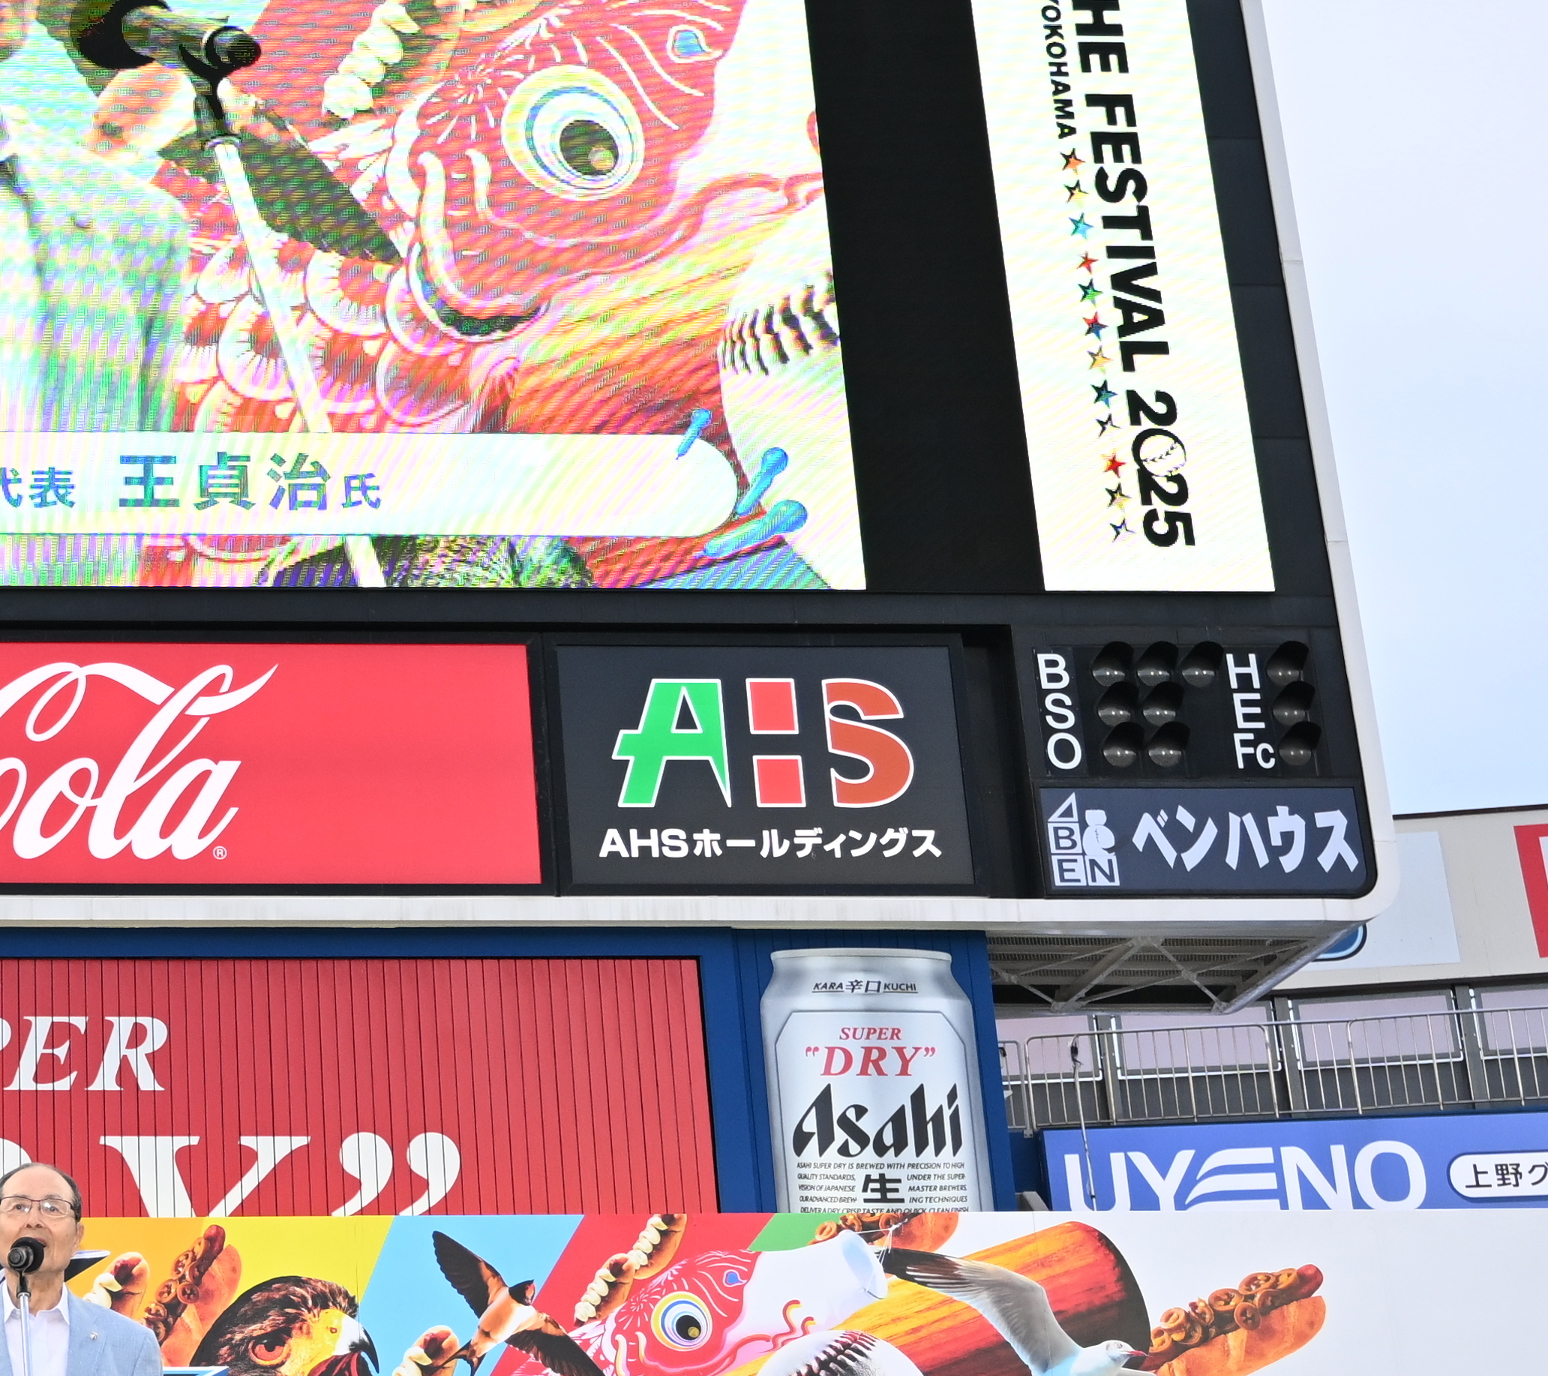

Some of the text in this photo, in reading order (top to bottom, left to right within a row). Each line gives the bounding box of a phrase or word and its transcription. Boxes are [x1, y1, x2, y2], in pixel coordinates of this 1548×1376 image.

[1084, 92, 1169, 372] FESTIVAL
[1127, 390, 1195, 548] 2025
[1037, 652, 1260, 690] B H
[1045, 692, 1265, 731] S E
[612, 677, 914, 809] AHS
[1048, 735, 1083, 772] O
[599, 827, 942, 861] AHSホールディングス
[1132, 805, 1360, 874] ベンハウス
[813, 980, 917, 993] KARA 辛口 KUCHI
[839, 1027, 902, 1040] SUPER
[793, 1083, 962, 1158] Asahi
[833, 1162, 847, 1170] DRY
[856, 1162, 885, 1170] BREWED
[887, 1162, 905, 1170] WITH
[907, 1162, 941, 1170] PRECISION
[907, 1173, 946, 1181] UNDER THE
[862, 1173, 905, 1203] 生
[925, 1195, 968, 1203] TECHNIQUES
